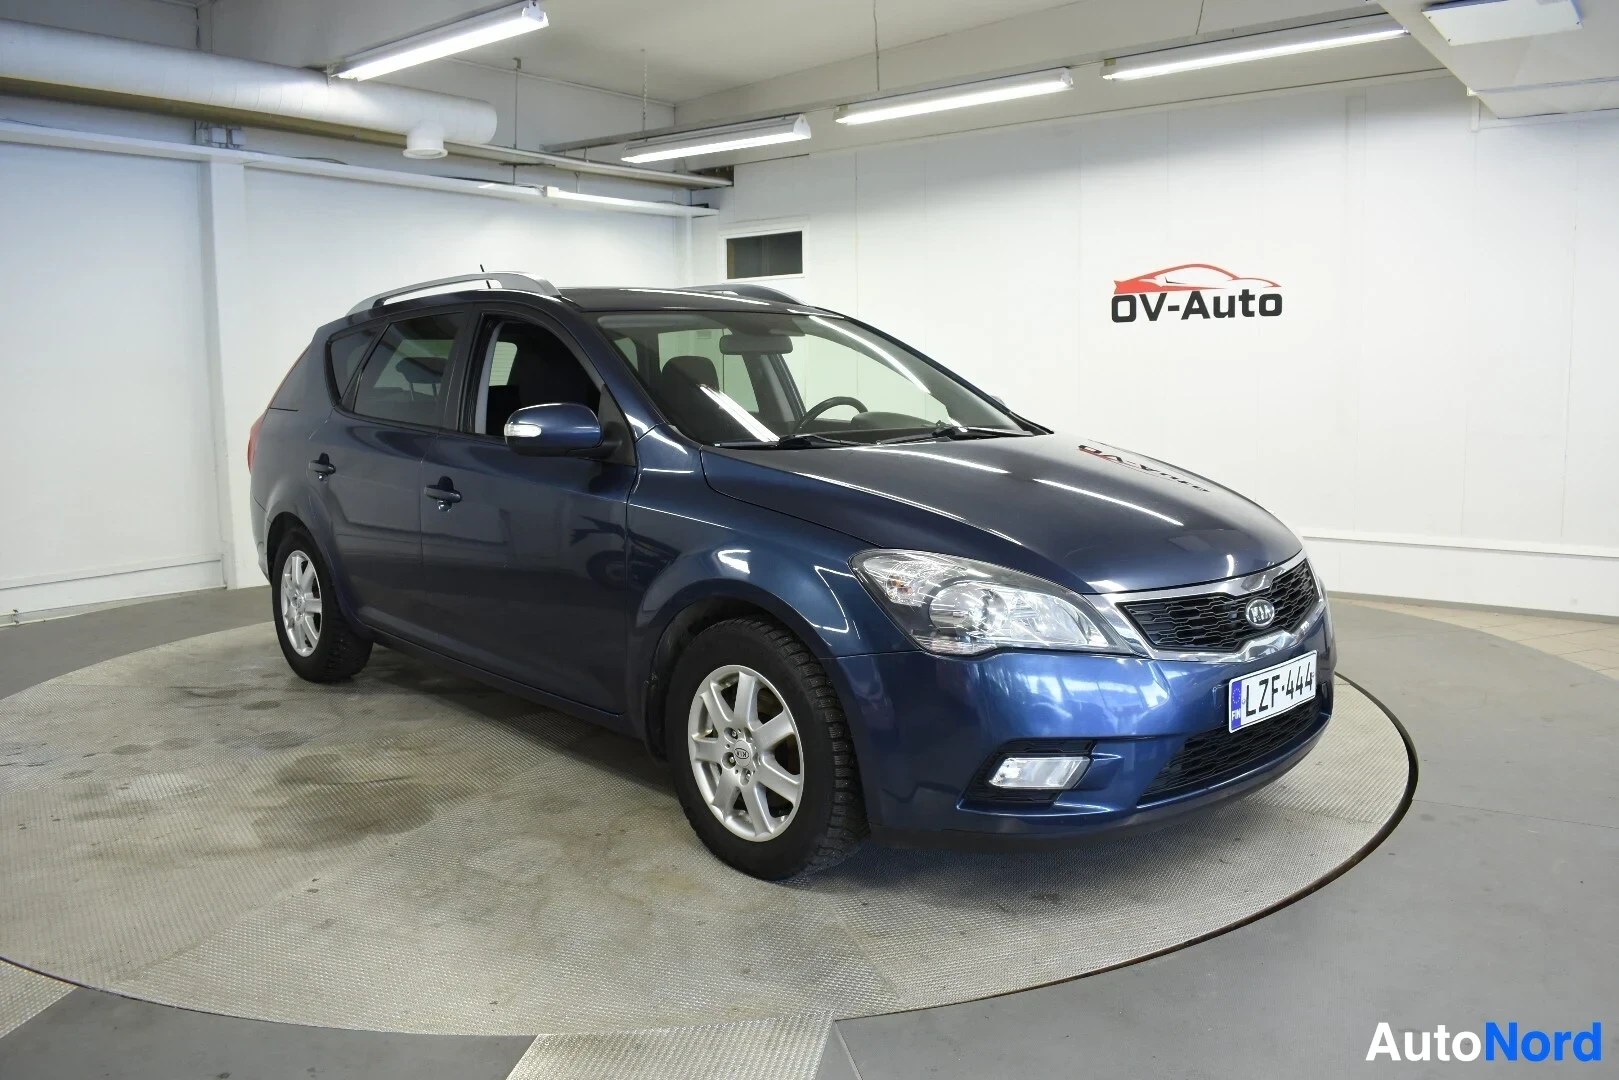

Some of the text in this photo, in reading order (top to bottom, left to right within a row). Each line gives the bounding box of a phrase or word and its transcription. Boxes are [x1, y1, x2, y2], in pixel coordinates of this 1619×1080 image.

[1111, 289, 1283, 323] OV-Auto
[1250, 604, 1272, 623] KIA
[1245, 661, 1313, 718] LZF-444
[1231, 708, 1241, 721] FIN
